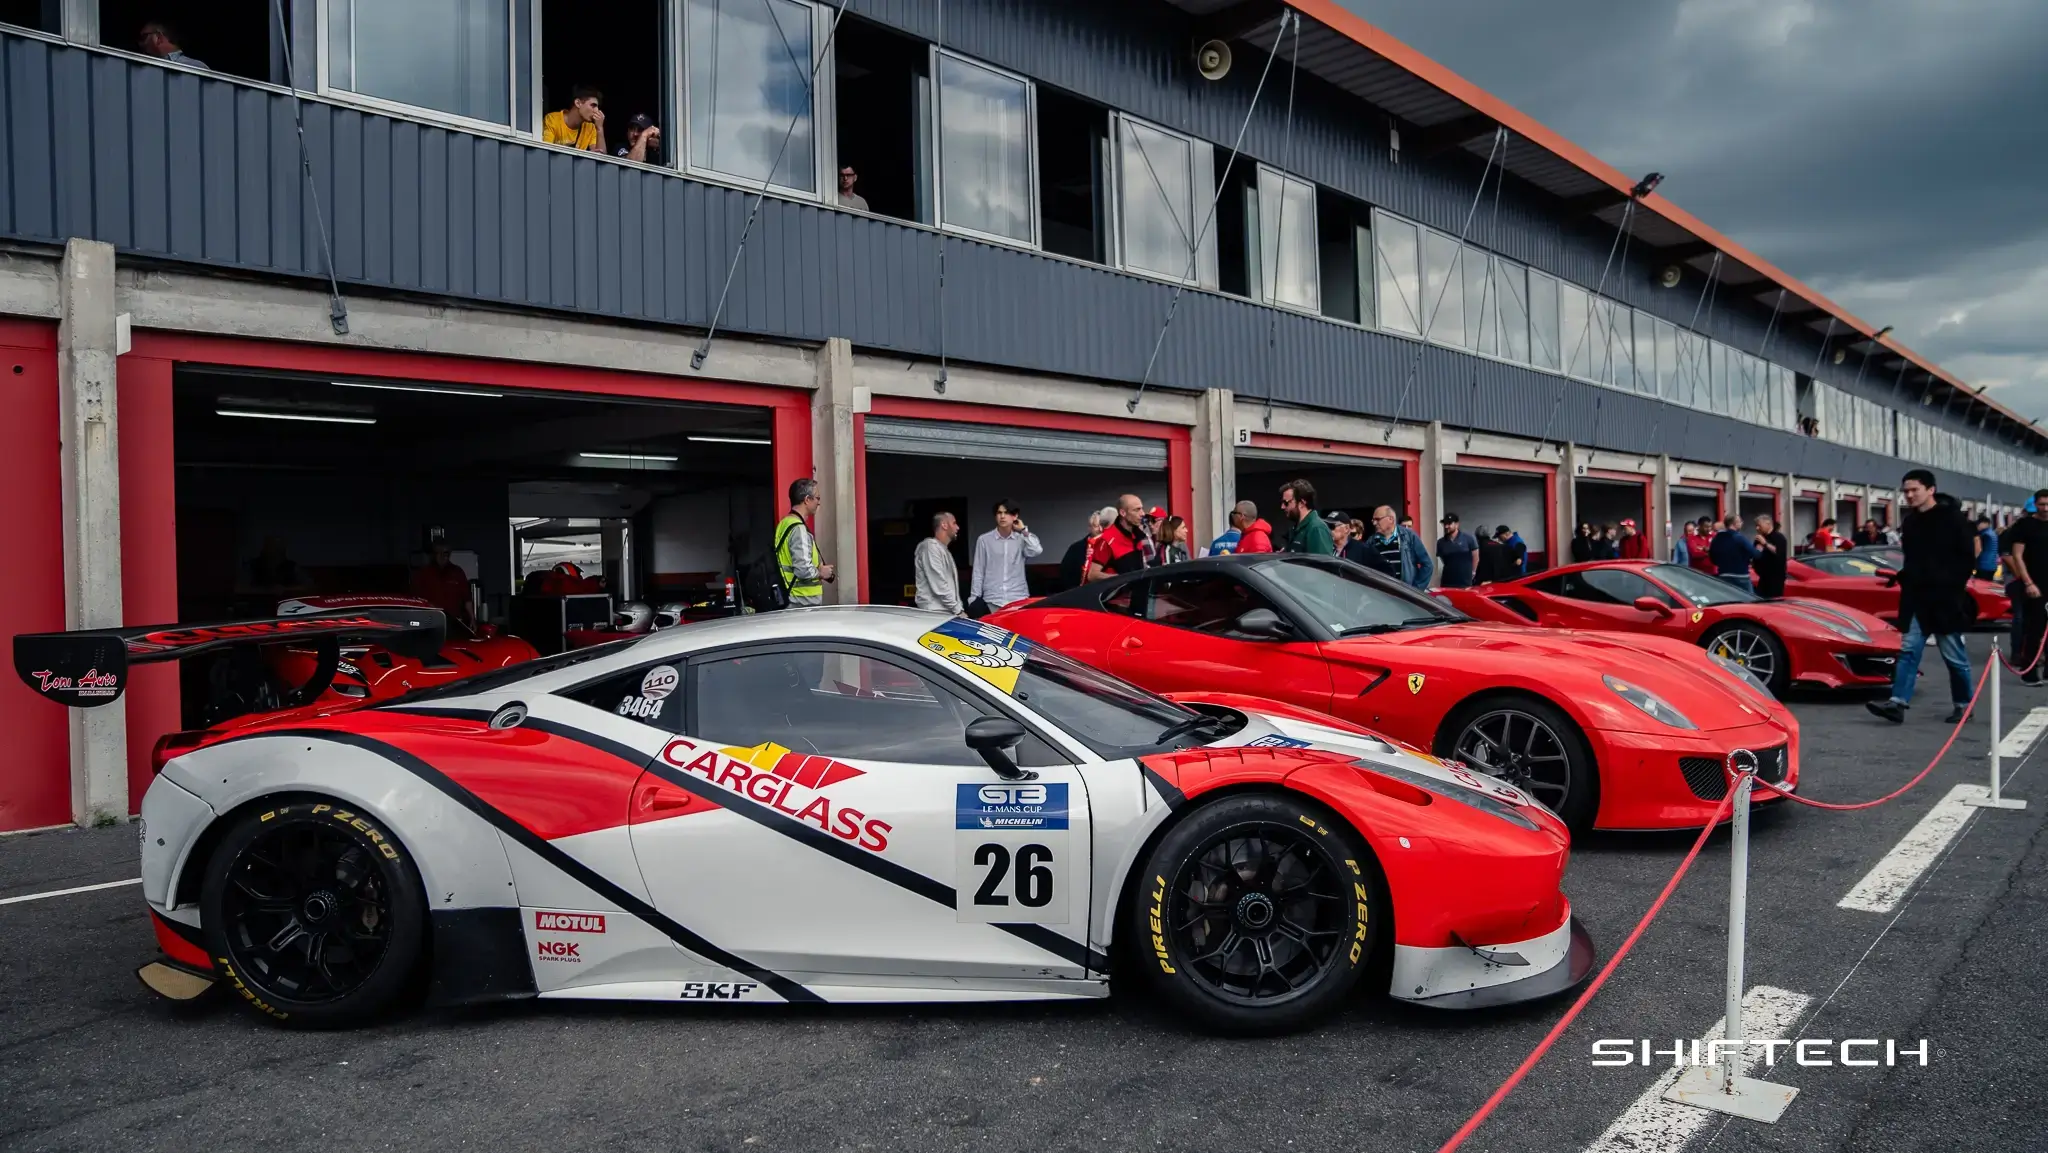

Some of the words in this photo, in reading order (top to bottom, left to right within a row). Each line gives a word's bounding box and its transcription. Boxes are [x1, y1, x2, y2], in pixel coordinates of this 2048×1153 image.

[1240, 429, 1247, 443] 5
[1578, 466, 1584, 474] 6
[32, 669, 72, 692] Toni
[78, 668, 117, 687] Auto
[644, 674, 676, 690] 110
[619, 695, 664, 719] 3464
[662, 739, 893, 852] CARGLASS
[978, 784, 1047, 804] GT3
[982, 805, 993, 813] LE
[995, 805, 1021, 813] MANS
[1023, 805, 1042, 813] CUP
[333, 809, 399, 860] ZERO
[974, 843, 1053, 907] 26
[539, 914, 603, 931] MOTUL
[1149, 875, 1176, 973] PIRELLI
[1350, 882, 1368, 964] ZERO
[538, 941, 580, 957] NGK
[680, 983, 757, 999] SKF
